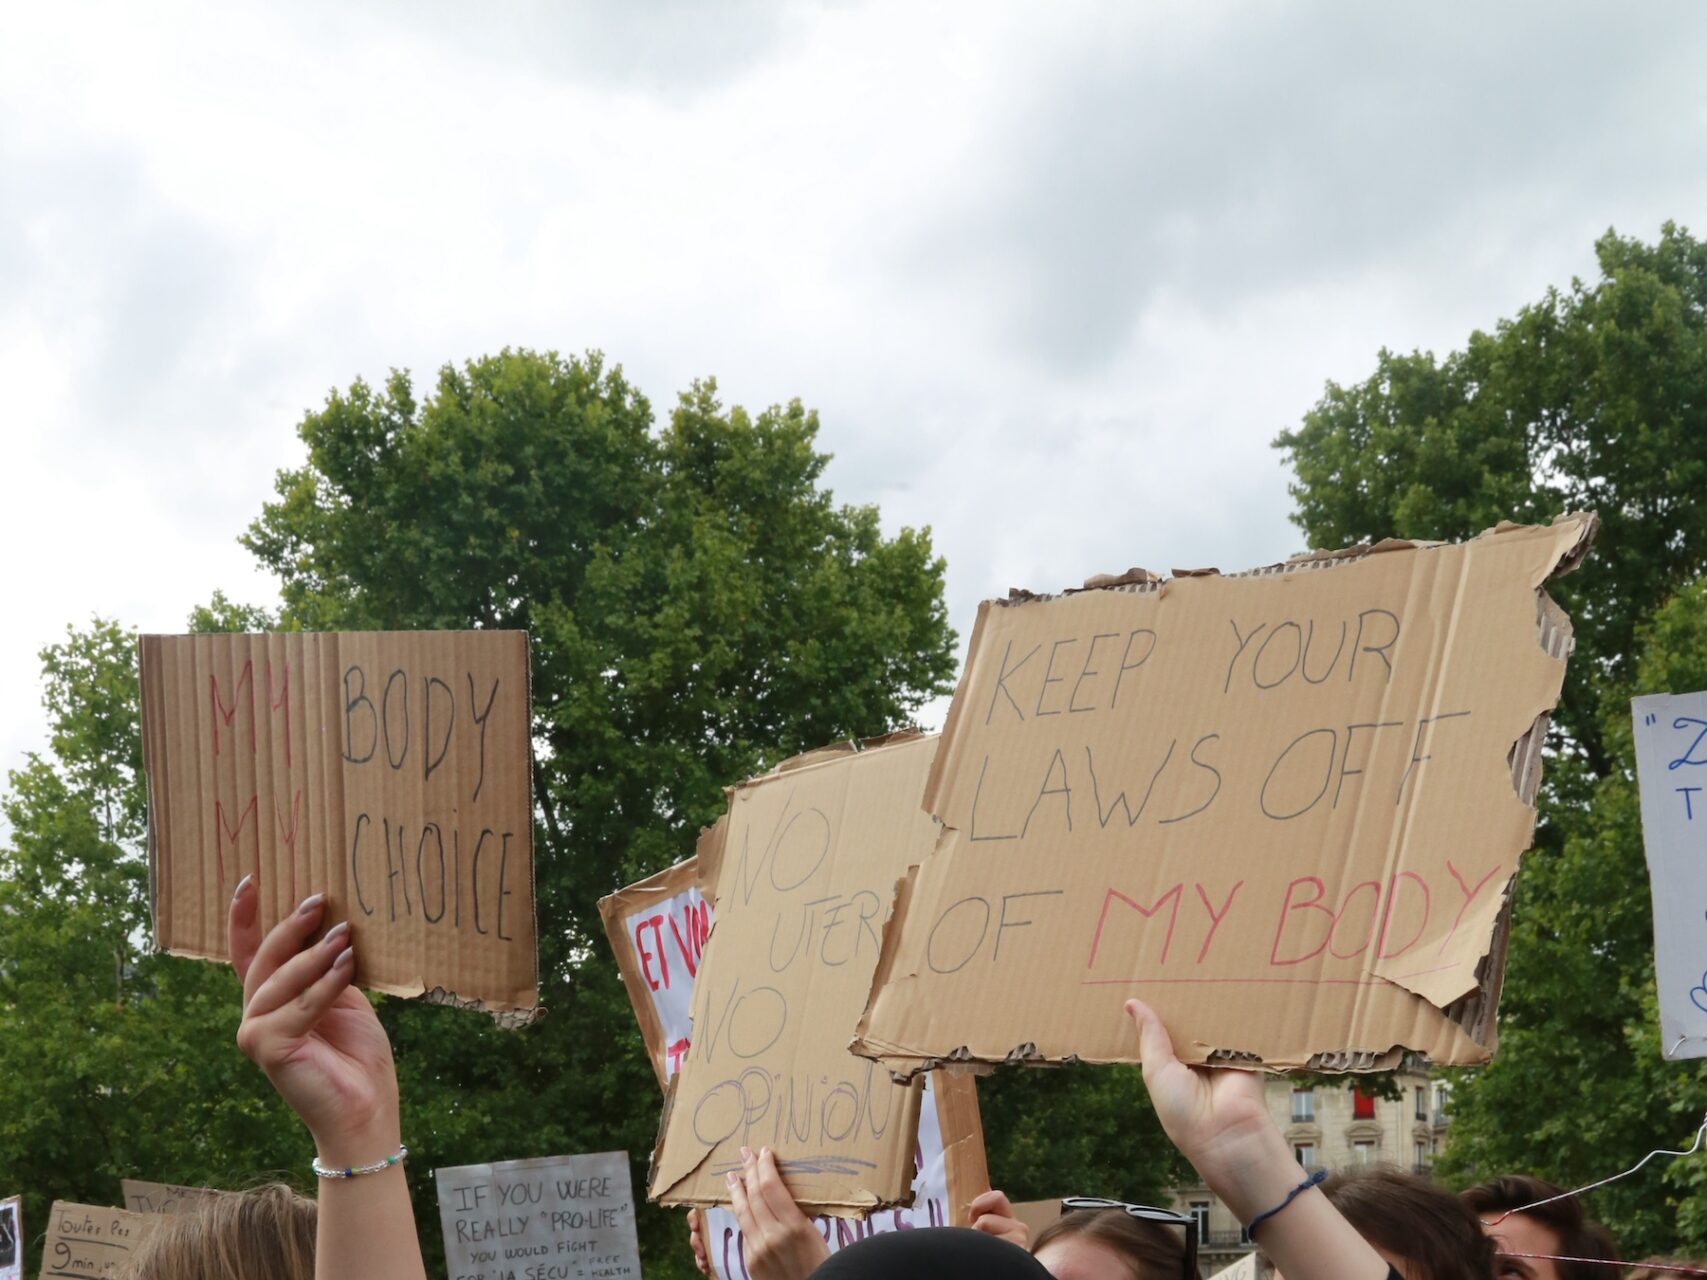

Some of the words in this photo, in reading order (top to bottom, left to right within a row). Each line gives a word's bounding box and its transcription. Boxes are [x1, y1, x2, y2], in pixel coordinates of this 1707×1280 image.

[985, 629, 1156, 725] KEEP
[1224, 609, 1400, 693] YOUR
[210, 659, 291, 768] MY
[342, 665, 498, 802] BODY
[970, 734, 1221, 841] LAWS
[1261, 712, 1470, 819] OFF
[216, 790, 300, 903] MY
[352, 812, 513, 941] CHOICE
[729, 788, 830, 912] NO
[636, 914, 670, 992] ET
[927, 891, 1063, 974] OF
[1088, 881, 1243, 969] MY
[1270, 862, 1501, 966] BODY
[697, 978, 787, 1063] NO
[56, 1209, 101, 1235] Toutes
[453, 1184, 488, 1212] IF
[498, 1181, 543, 1206] YOU
[556, 1177, 612, 1200] WERE
[456, 1216, 530, 1244] REALLY
[51, 1242, 71, 1269] 9
[470, 1250, 497, 1265] YOU
[505, 1245, 549, 1260] WOULD
